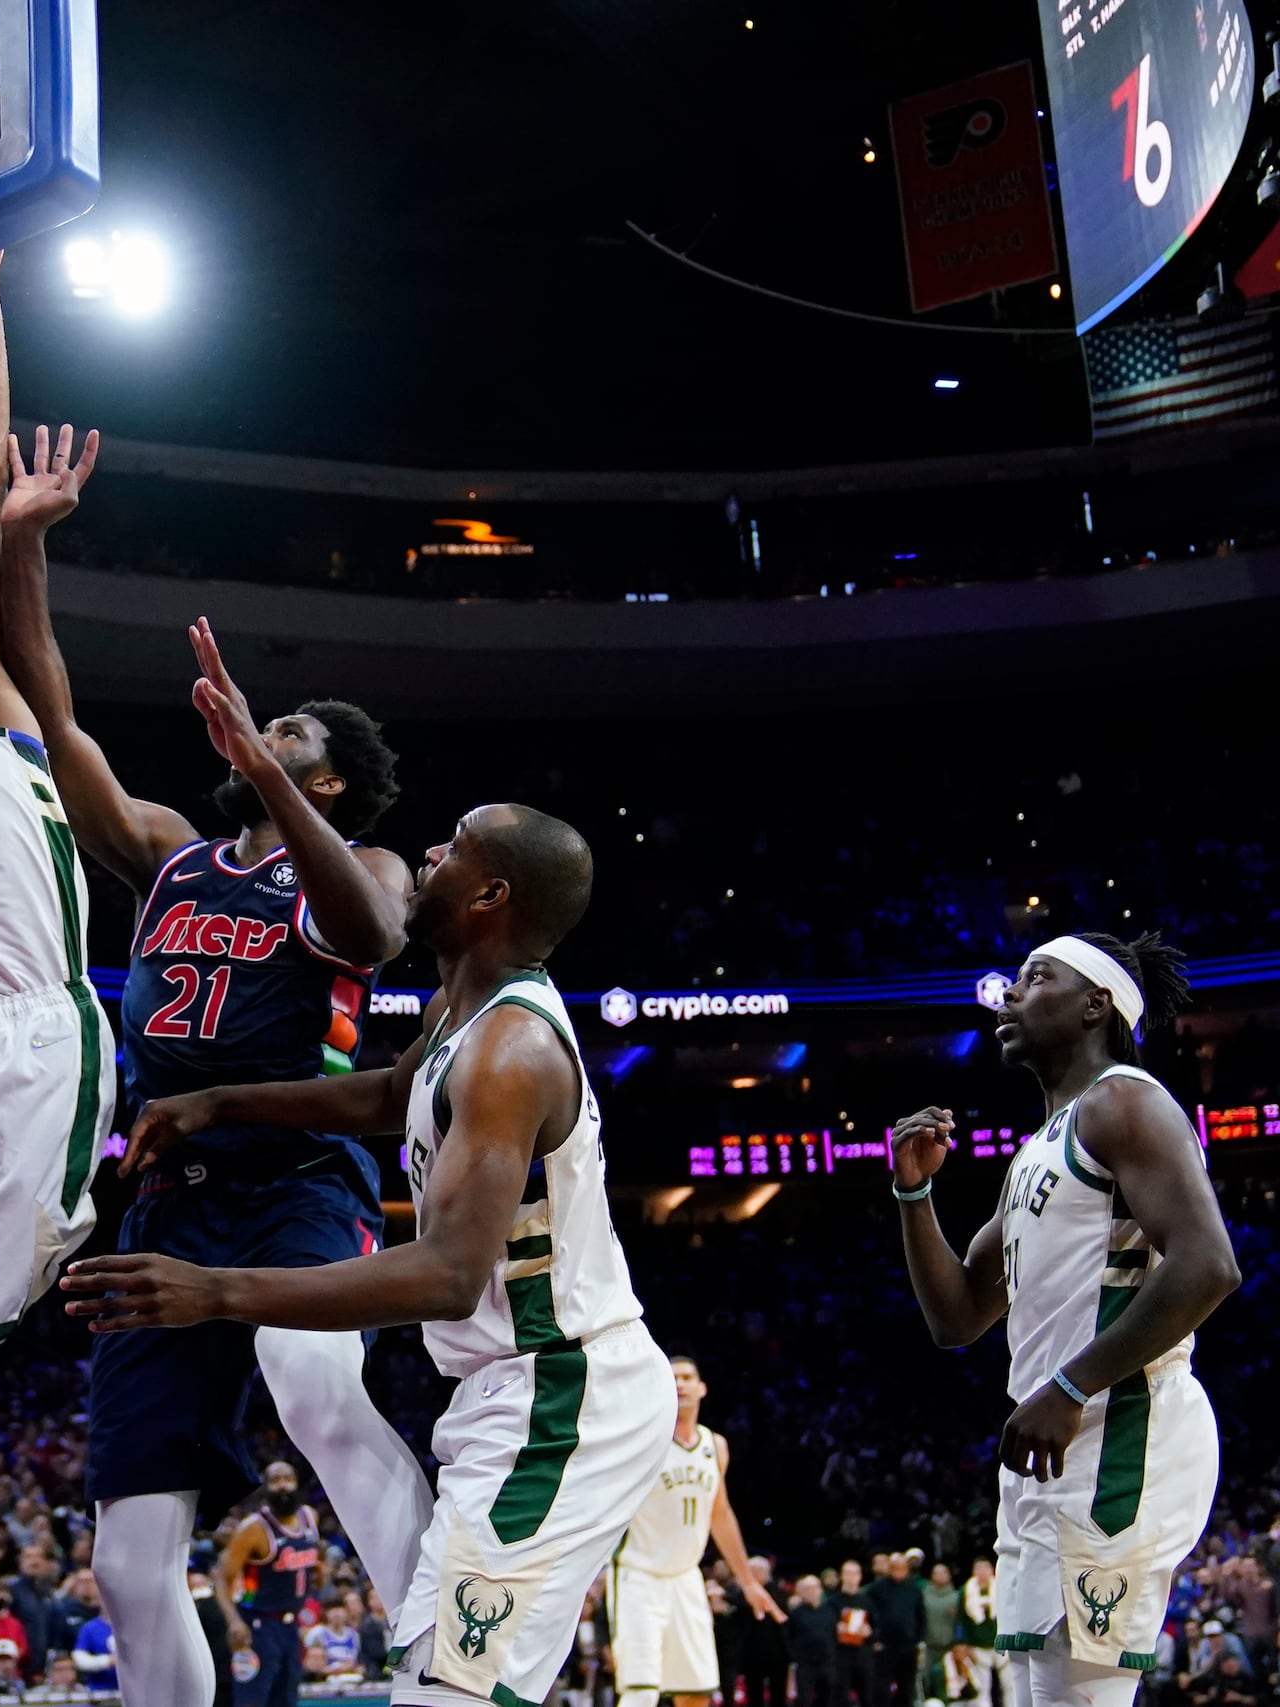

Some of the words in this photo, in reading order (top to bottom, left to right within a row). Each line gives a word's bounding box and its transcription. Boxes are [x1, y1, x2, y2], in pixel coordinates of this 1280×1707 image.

[1061, 4, 1082, 35] BLK
[1065, 31, 1085, 59] STL
[141, 901, 289, 962] Sixers
[144, 963, 232, 1039] 21
[641, 993, 789, 1020] crypto.com
[683, 1496, 697, 1527] 11
